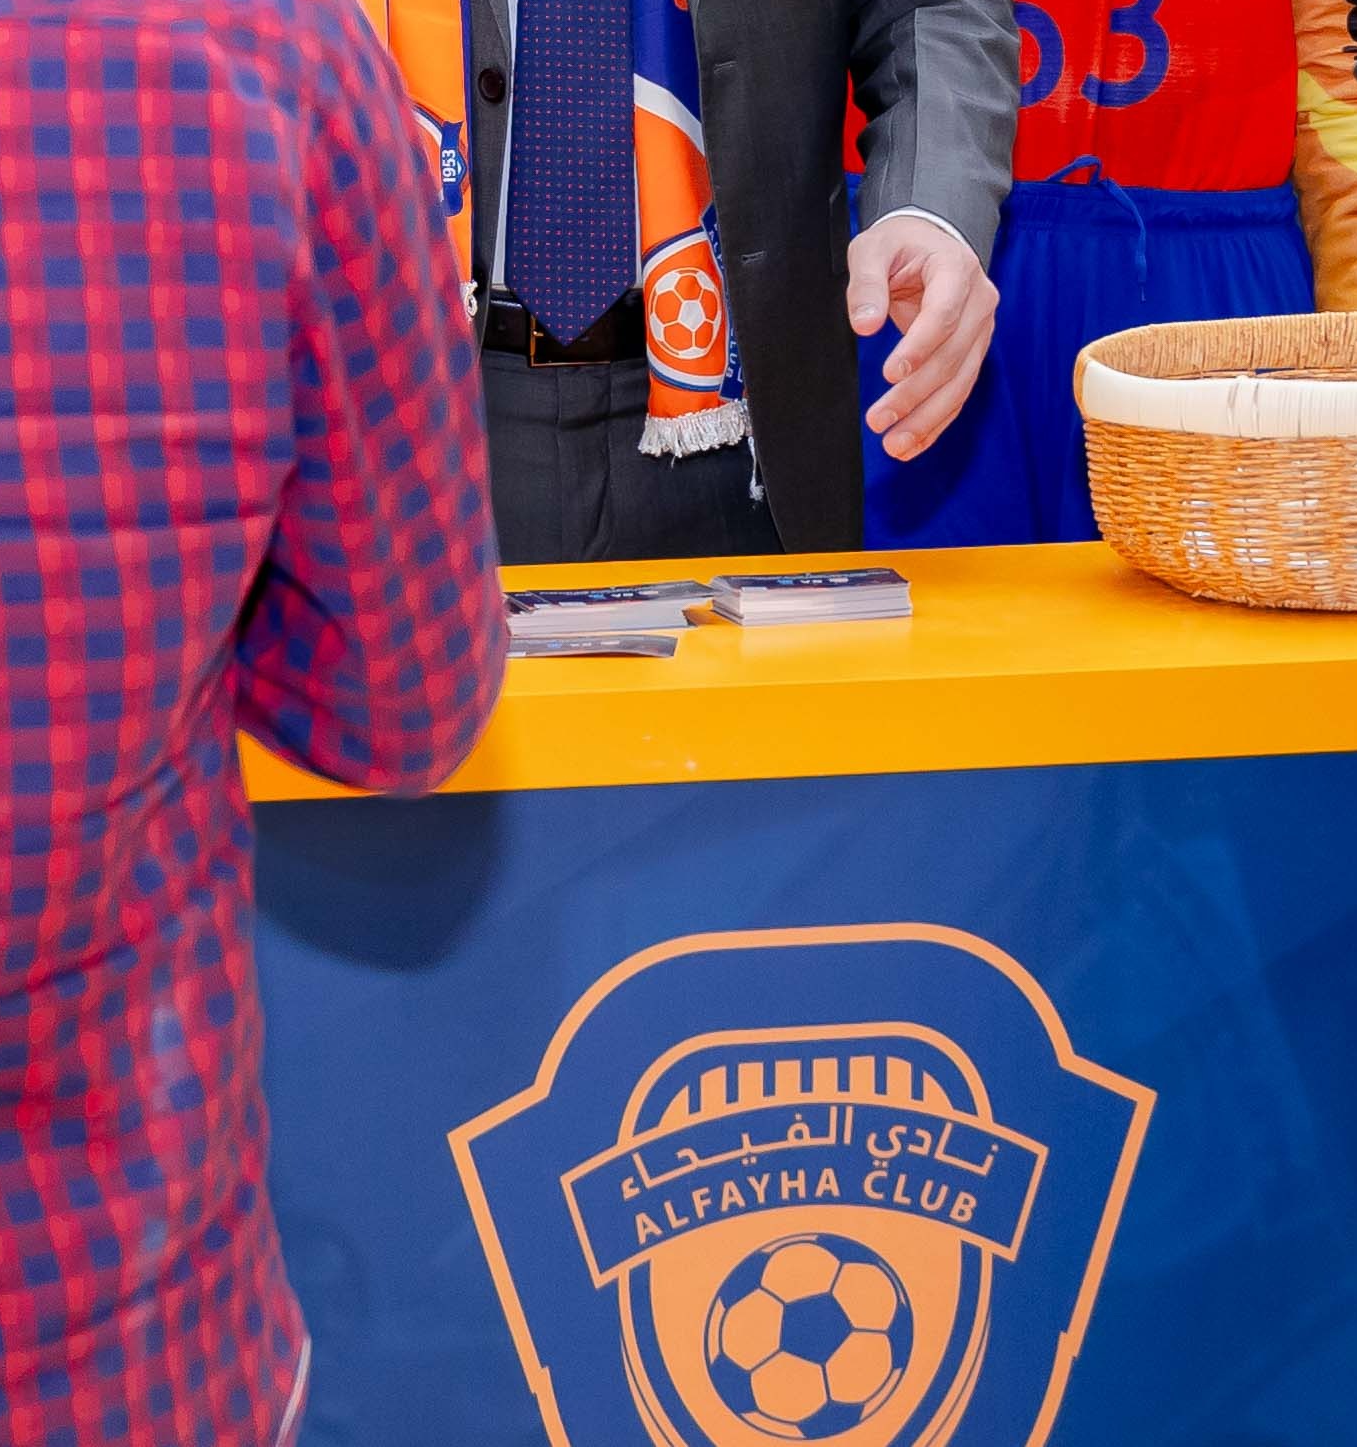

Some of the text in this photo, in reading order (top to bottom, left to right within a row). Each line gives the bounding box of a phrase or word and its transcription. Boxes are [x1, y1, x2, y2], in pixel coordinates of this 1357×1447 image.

[442, 149, 456, 183] 1953
[621, 1104, 999, 1201] نادي الفيحاء
[635, 1167, 978, 1245] ALFAYHA CLUB
